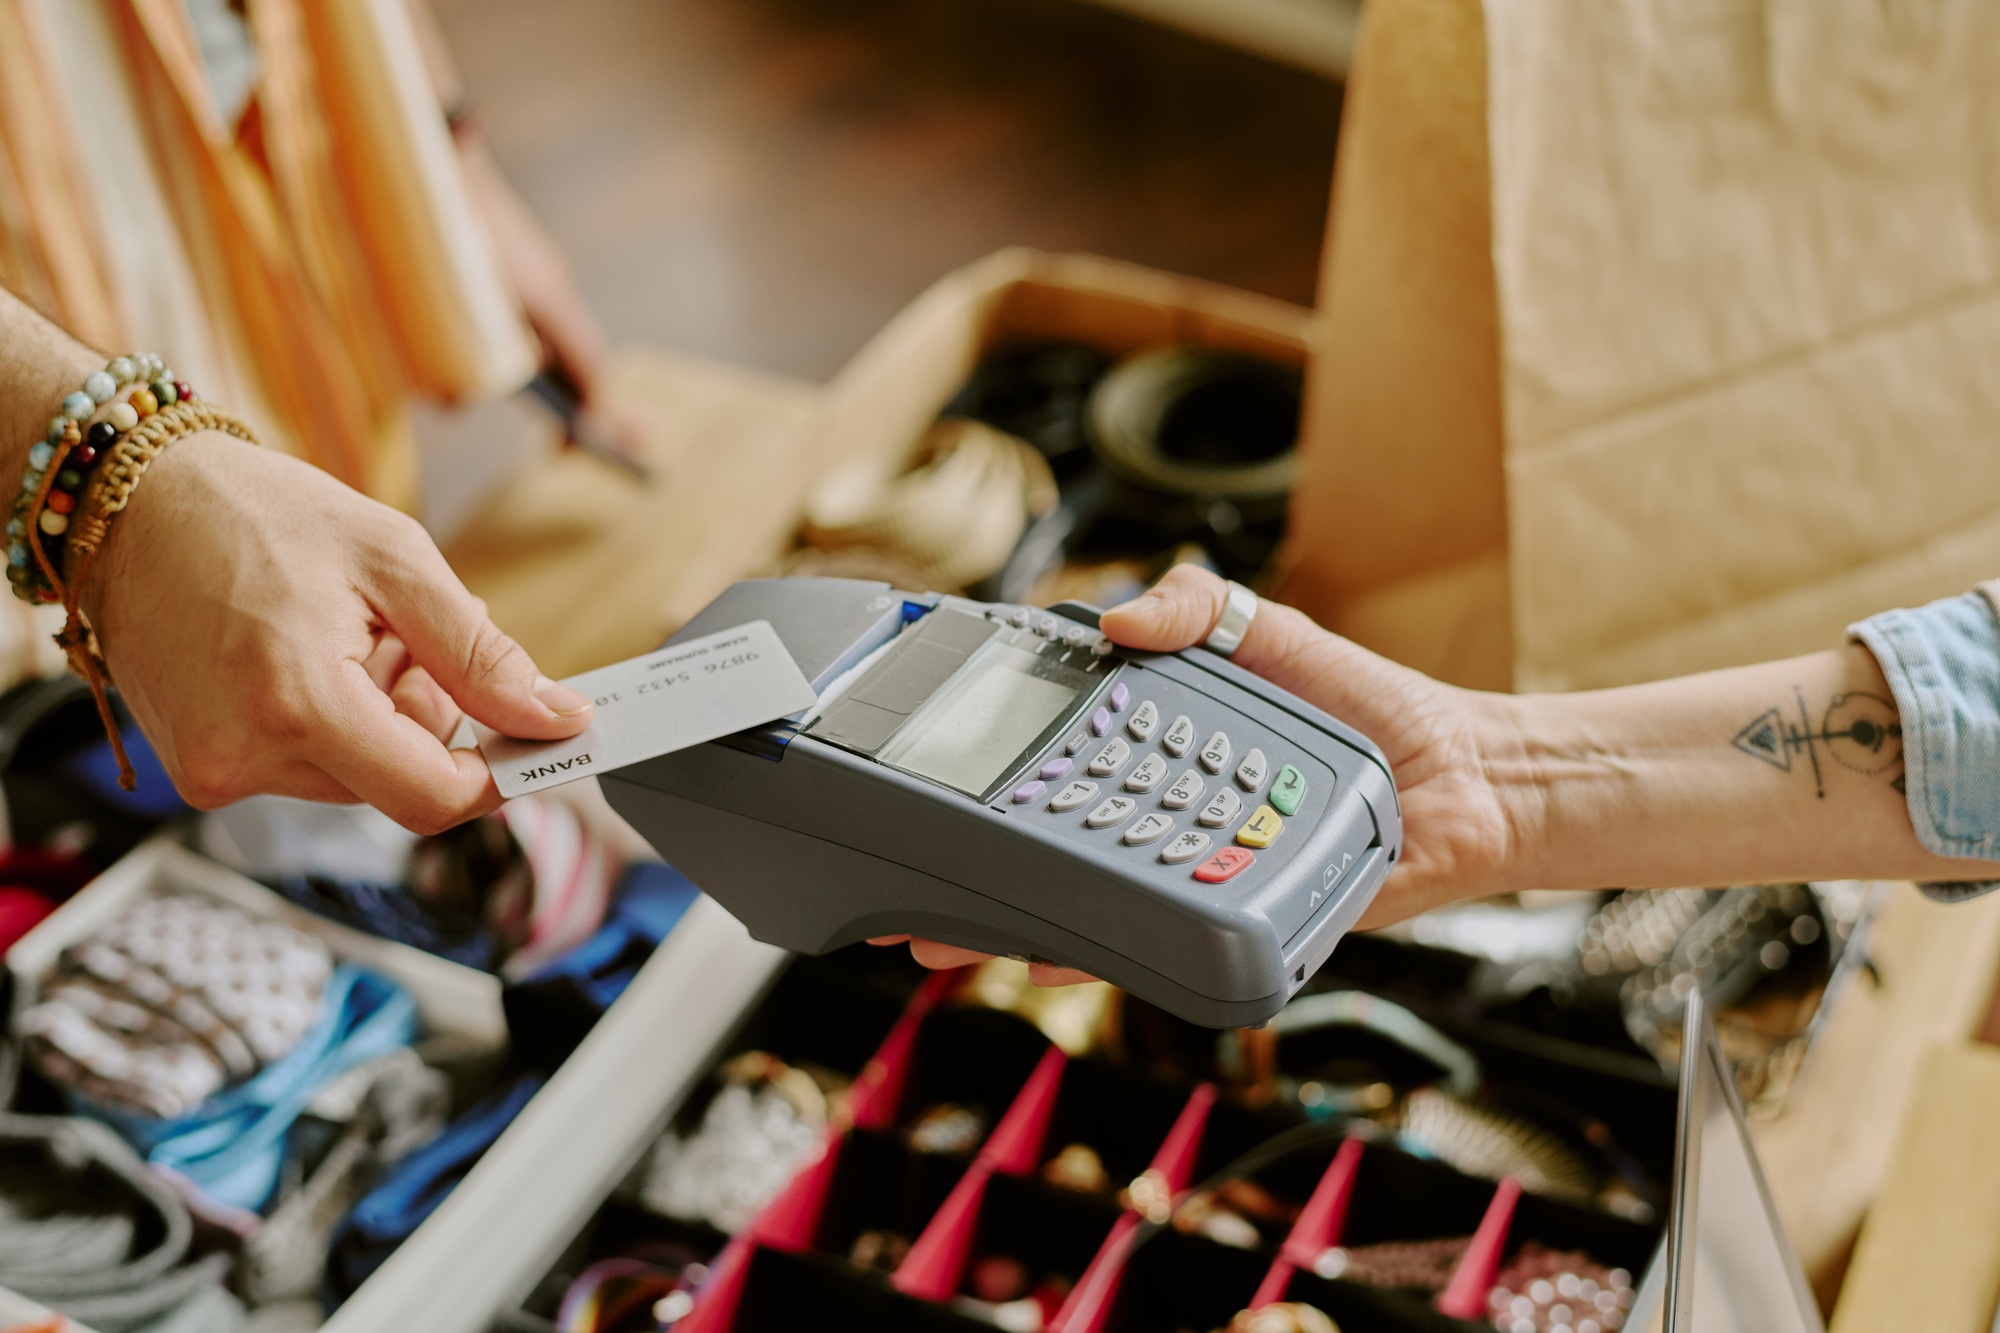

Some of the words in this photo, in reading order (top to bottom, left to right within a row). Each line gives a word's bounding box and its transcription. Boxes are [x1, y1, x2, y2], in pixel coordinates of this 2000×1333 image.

[713, 635, 750, 650] NAME
[648, 648, 709, 671] SURNAME
[704, 651, 759, 674] 9876
[636, 671, 690, 695] 5432
[595, 691, 622, 707] 10
[1139, 706, 1151, 719] DEF
[1133, 718, 1149, 728] 3
[1174, 722, 1187, 735] MNO
[1168, 734, 1185, 745] 6
[1211, 738, 1225, 751] WXY
[1104, 743, 1116, 756] ABC
[1097, 755, 1116, 767] 2
[1206, 751, 1222, 762] 9
[520, 753, 593, 782] BANK
[1140, 762, 1152, 772] JKL
[1133, 772, 1151, 782] 5
[1176, 776, 1190, 788] TUV
[1073, 783, 1090, 792] 1
[1171, 788, 1189, 799] 8
[1098, 807, 1111, 818] GHI
[1110, 798, 1127, 810] 4
[1207, 806, 1225, 817] 0
[1135, 823, 1148, 835] PRS
[1145, 815, 1162, 827] 7
